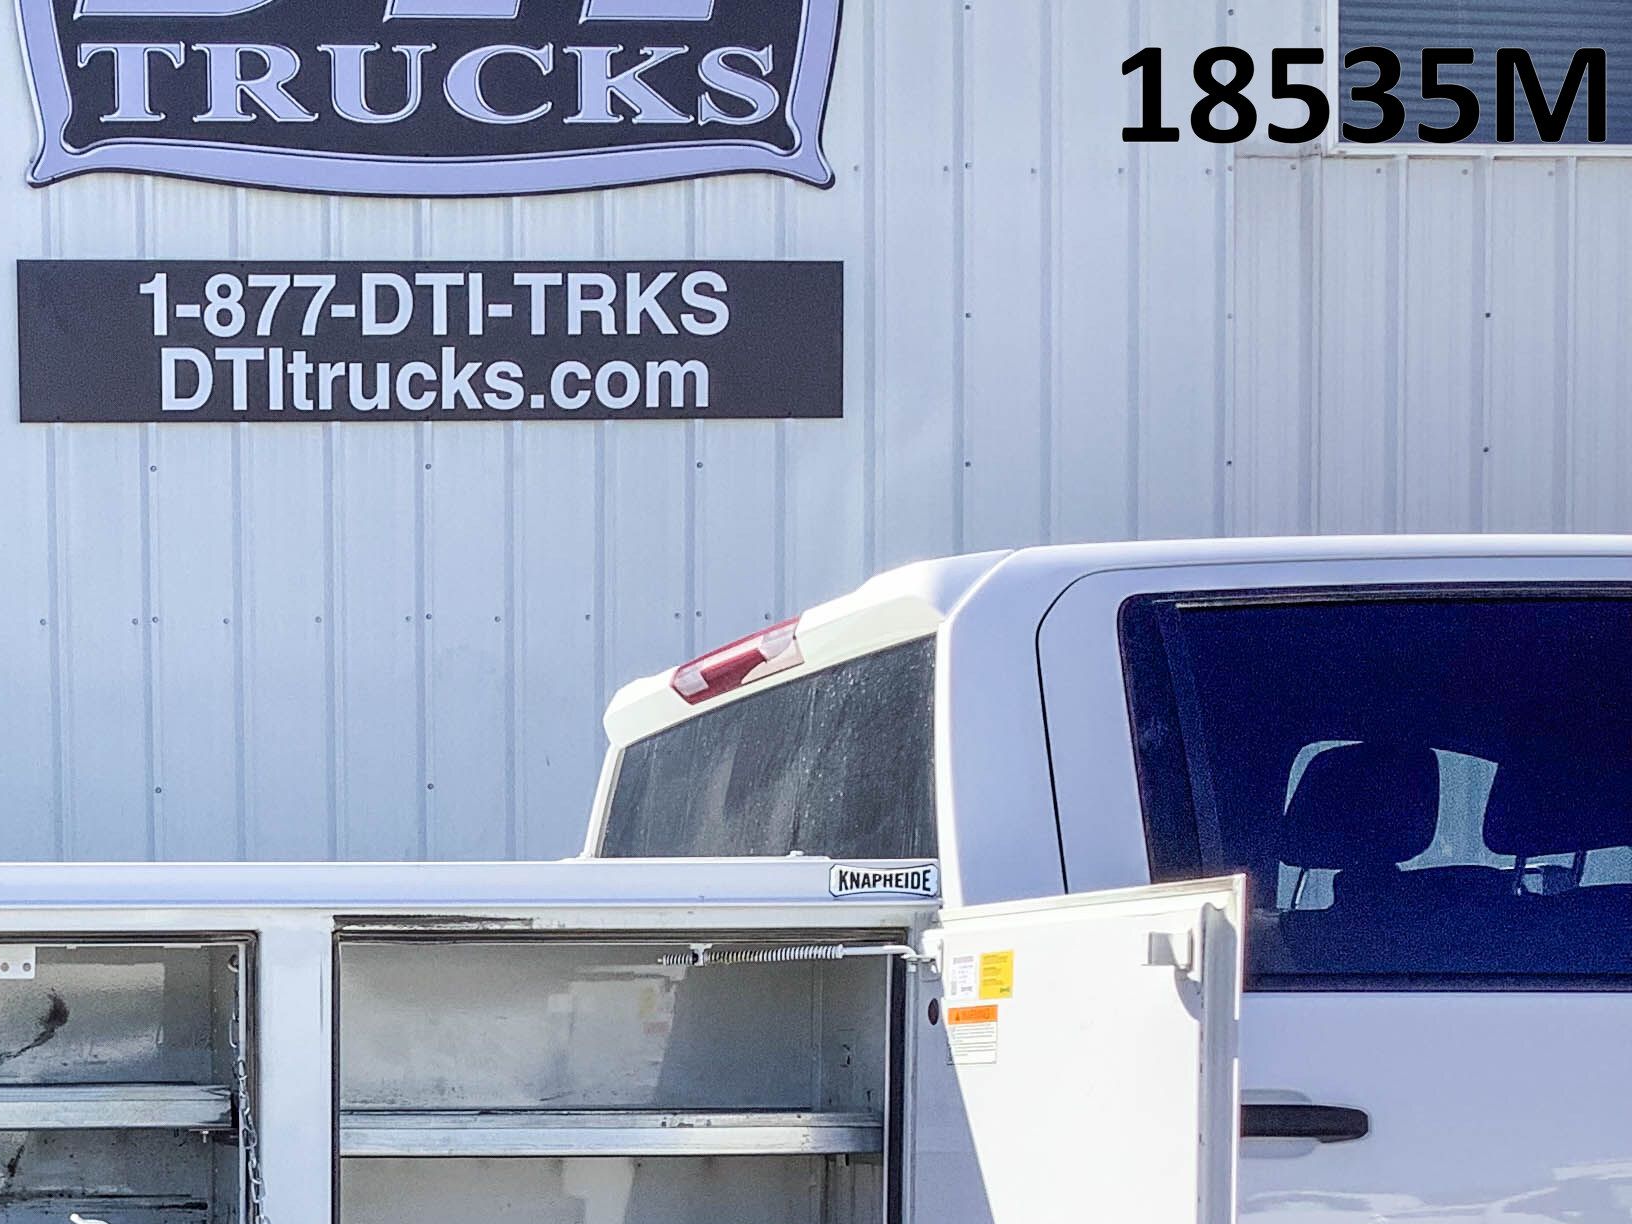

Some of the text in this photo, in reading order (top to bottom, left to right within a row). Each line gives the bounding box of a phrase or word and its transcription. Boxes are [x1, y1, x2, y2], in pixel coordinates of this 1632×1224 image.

[76, 42, 782, 126] TRUCKS
[139, 271, 732, 337] 1-877-DTI-TRKS
[159, 347, 710, 413] DTItrucks.com
[838, 868, 931, 892] KNAPHEIDE
